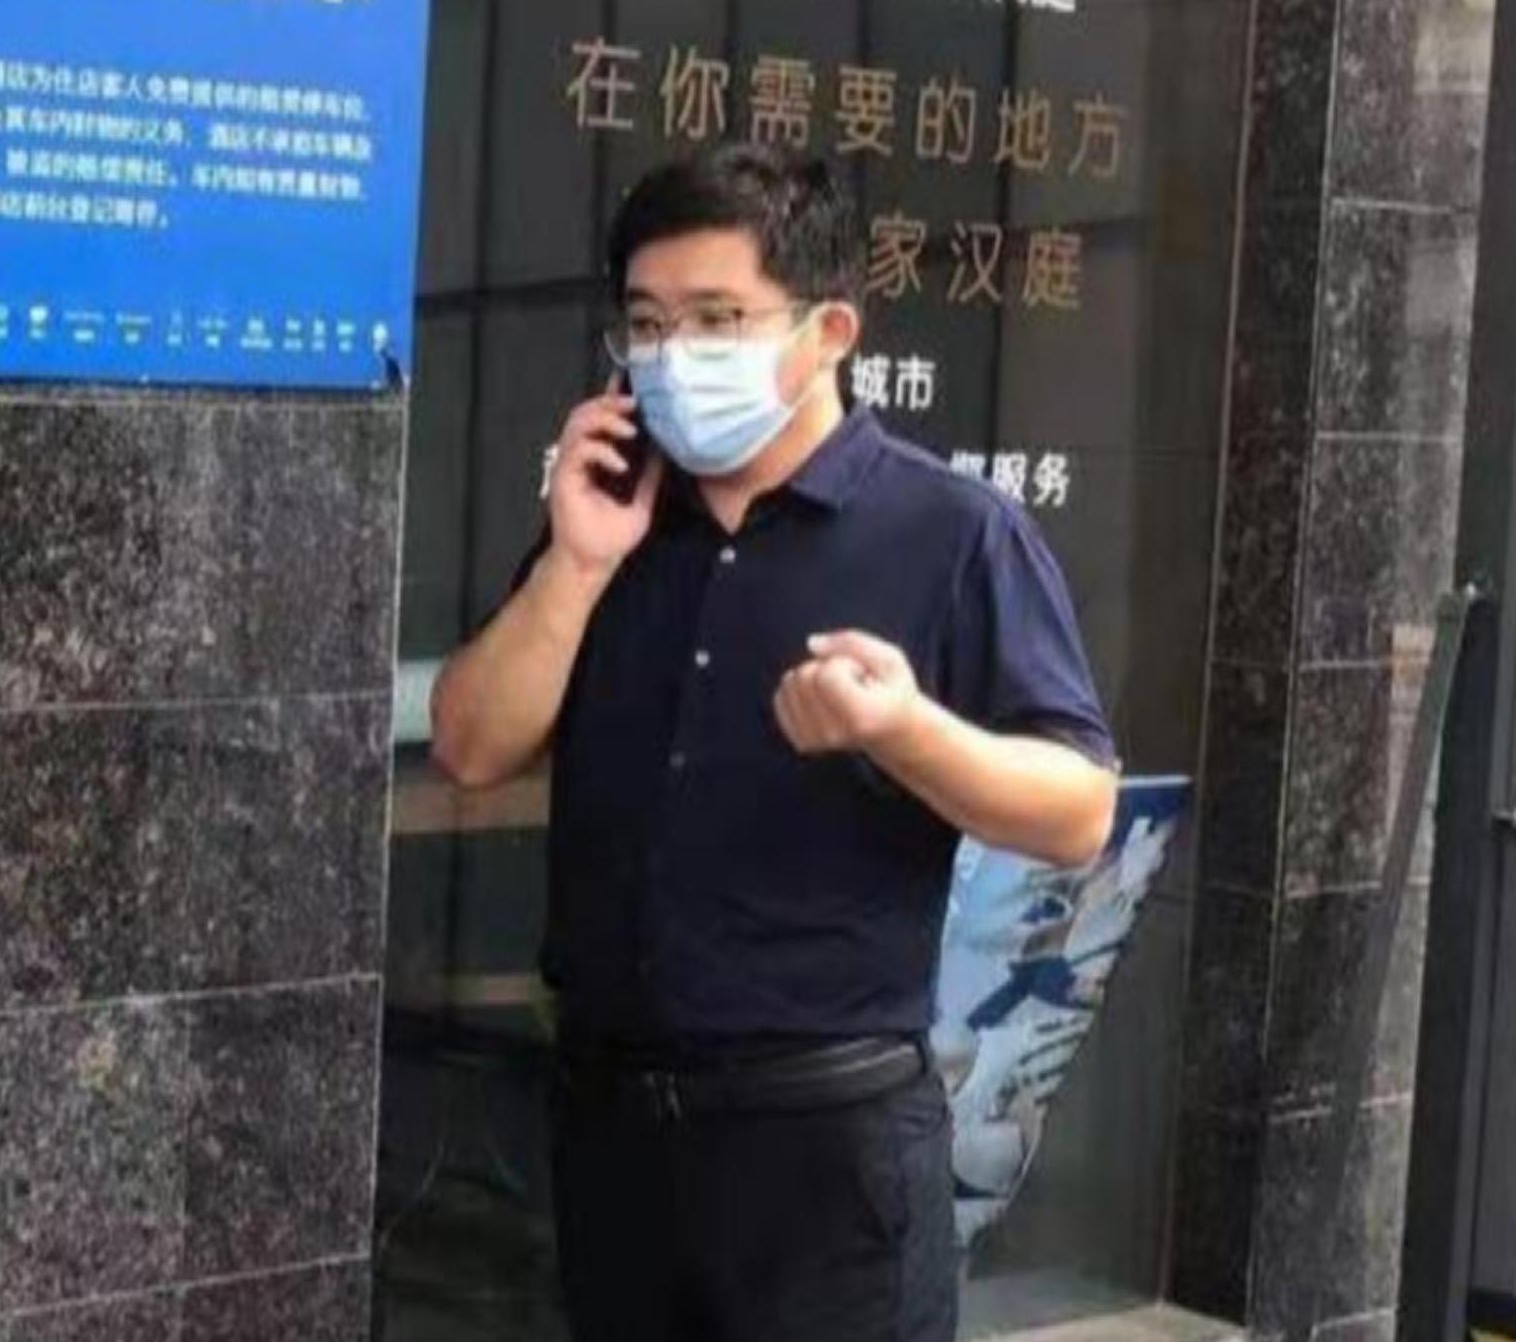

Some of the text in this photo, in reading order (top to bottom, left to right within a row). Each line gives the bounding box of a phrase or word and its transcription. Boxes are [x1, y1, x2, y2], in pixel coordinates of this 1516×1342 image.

[566, 36, 1132, 179] 在你需要的地方
[864, 209, 1084, 312] 家汉庭
[850, 352, 936, 411] 城市
